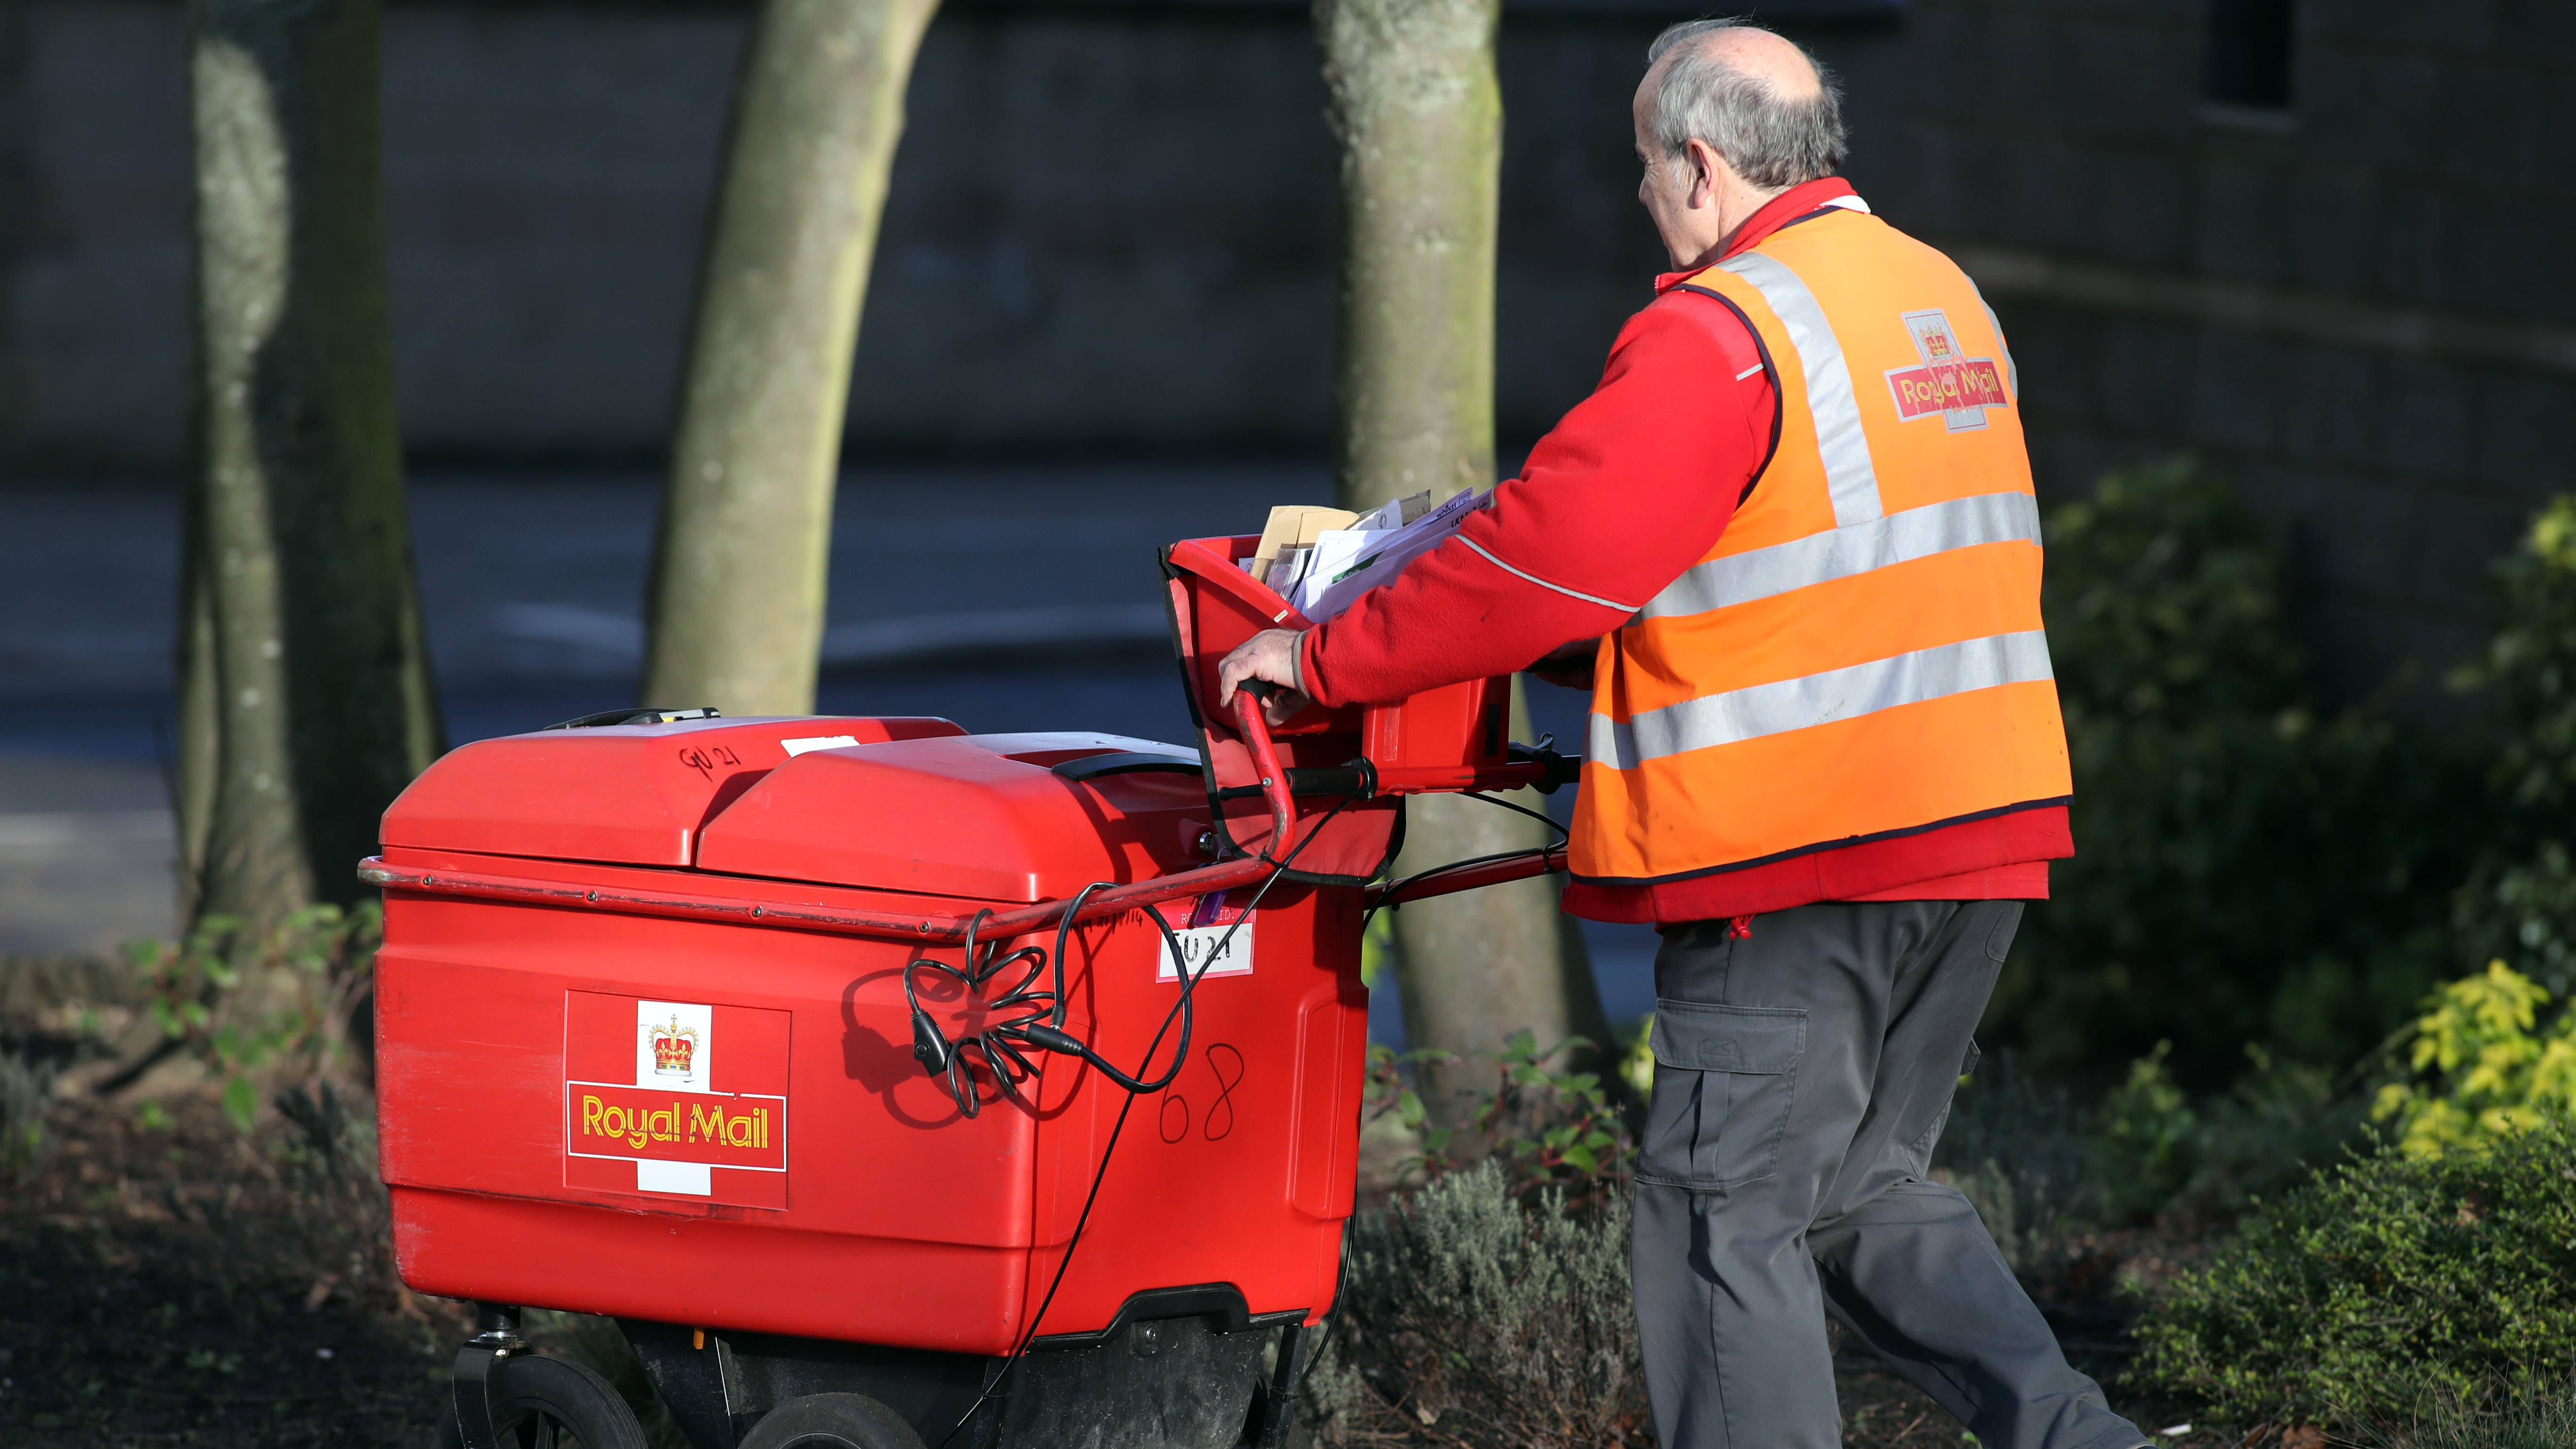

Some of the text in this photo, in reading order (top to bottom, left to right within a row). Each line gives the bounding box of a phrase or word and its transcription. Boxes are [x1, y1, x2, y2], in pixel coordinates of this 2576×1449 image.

[1960, 368, 1999, 394] Mail
[1436, 503, 1457, 517] whistl
[713, 745, 741, 765] 21
[1218, 909, 1235, 921] ID.
[1159, 1042, 1245, 1144] 68
[583, 1095, 768, 1149] Royal Mail
